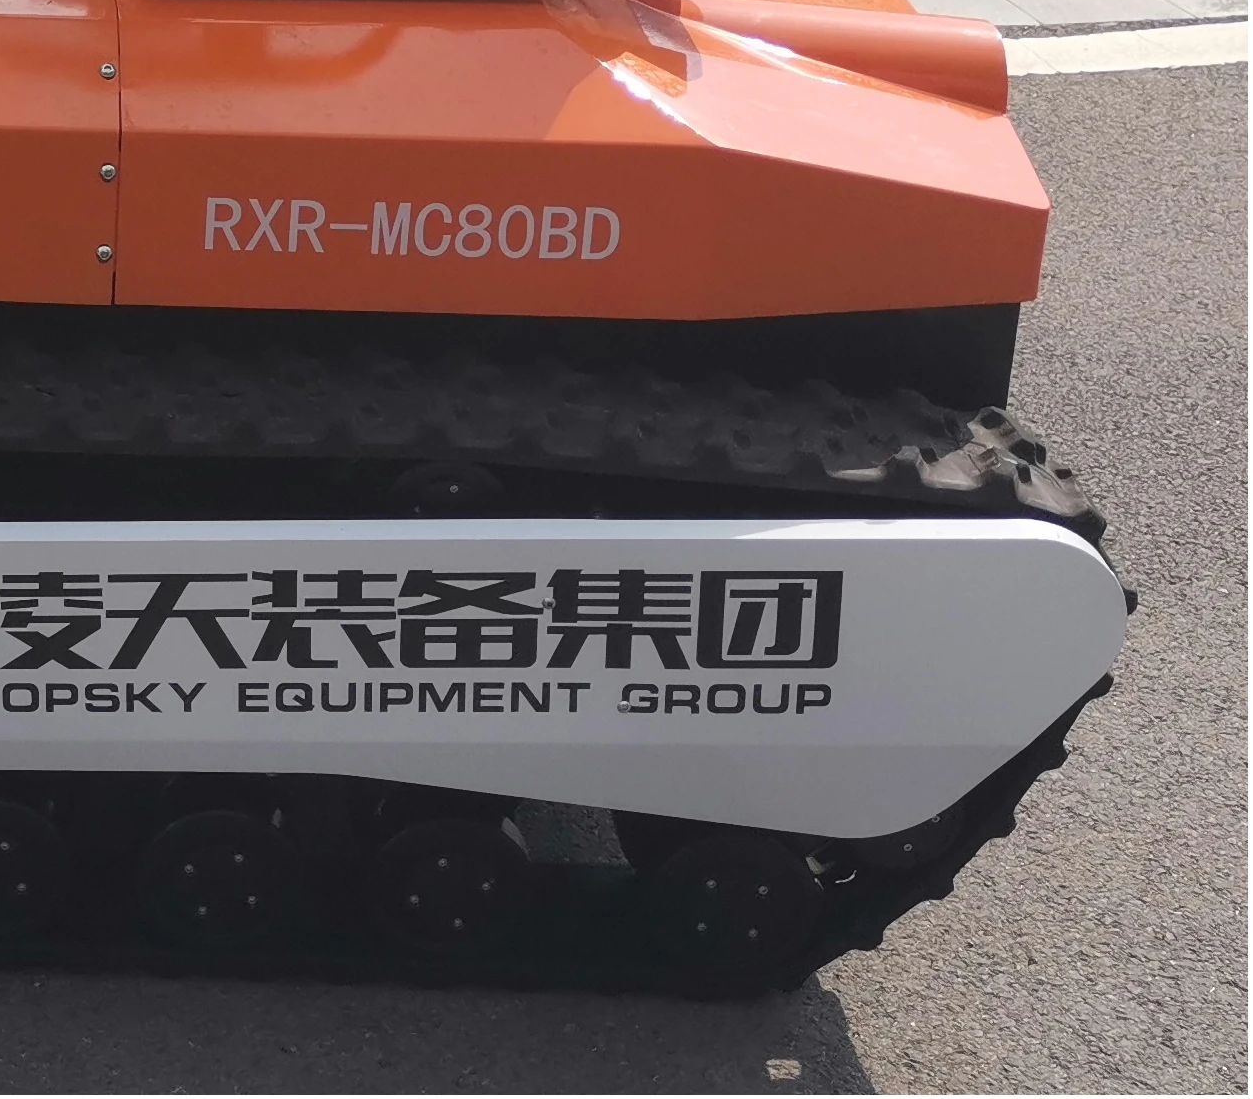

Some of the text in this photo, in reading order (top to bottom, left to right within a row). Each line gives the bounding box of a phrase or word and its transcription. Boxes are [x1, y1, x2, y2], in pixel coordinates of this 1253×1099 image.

[204, 197, 621, 259] RXR-MC80BD
[237, 682, 591, 714] EQUIPMENT
[622, 683, 833, 715] GROUP
